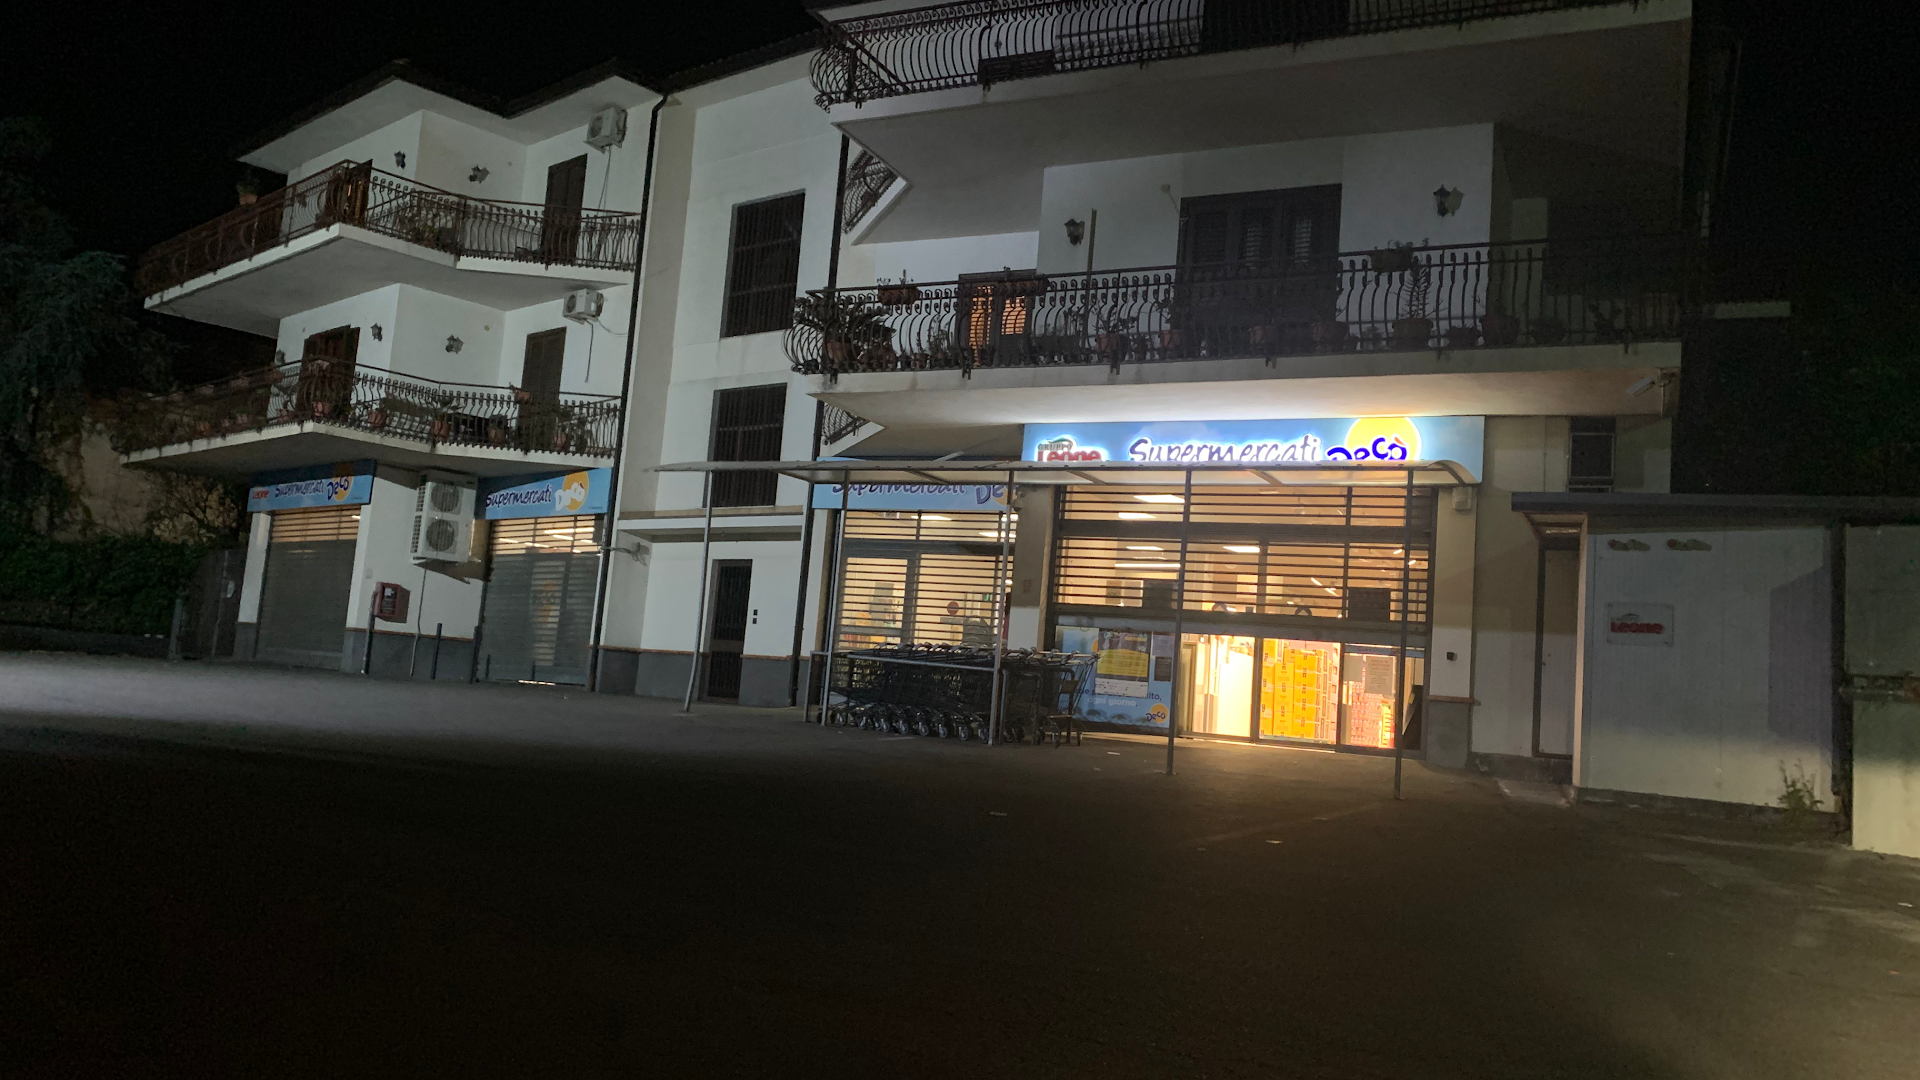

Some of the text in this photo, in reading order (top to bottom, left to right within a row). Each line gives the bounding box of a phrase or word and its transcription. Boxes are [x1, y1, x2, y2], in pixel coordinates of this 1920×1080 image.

[1038, 443, 1073, 451] GRUPPO
[1129, 435, 1318, 461] Supermercati
[485, 483, 552, 508] Supermercati
